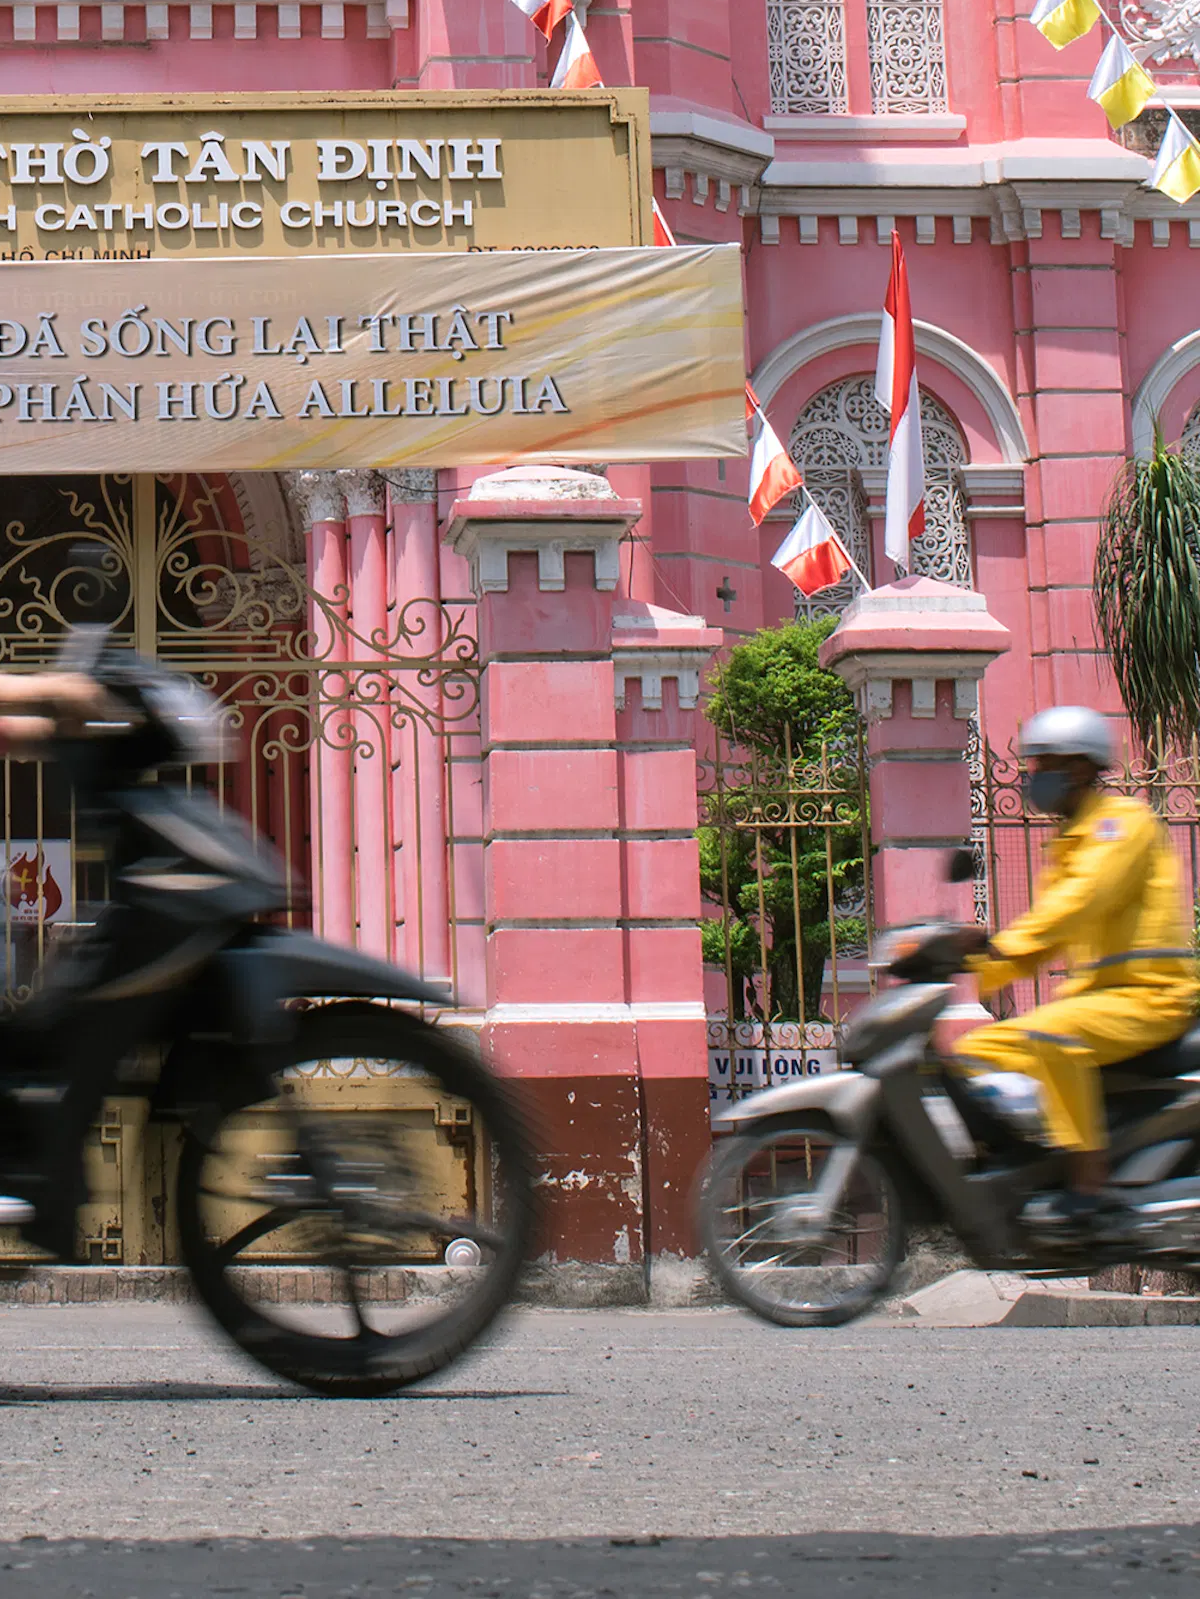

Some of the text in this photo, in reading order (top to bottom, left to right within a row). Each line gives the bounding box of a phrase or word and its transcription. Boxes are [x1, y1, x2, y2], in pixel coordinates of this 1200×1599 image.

[141, 131, 291, 182] TÂN
[318, 138, 502, 190] ĐỊNH
[34, 201, 263, 232] CATHOLIC
[280, 199, 473, 228] CHURCH
[80, 304, 237, 358] SỐNG
[250, 314, 347, 364] LẠI
[358, 304, 513, 360] THẬT
[155, 372, 284, 421] HỨA
[299, 374, 569, 419] ALLELUIA
[762, 1055, 821, 1076] LÒNG
